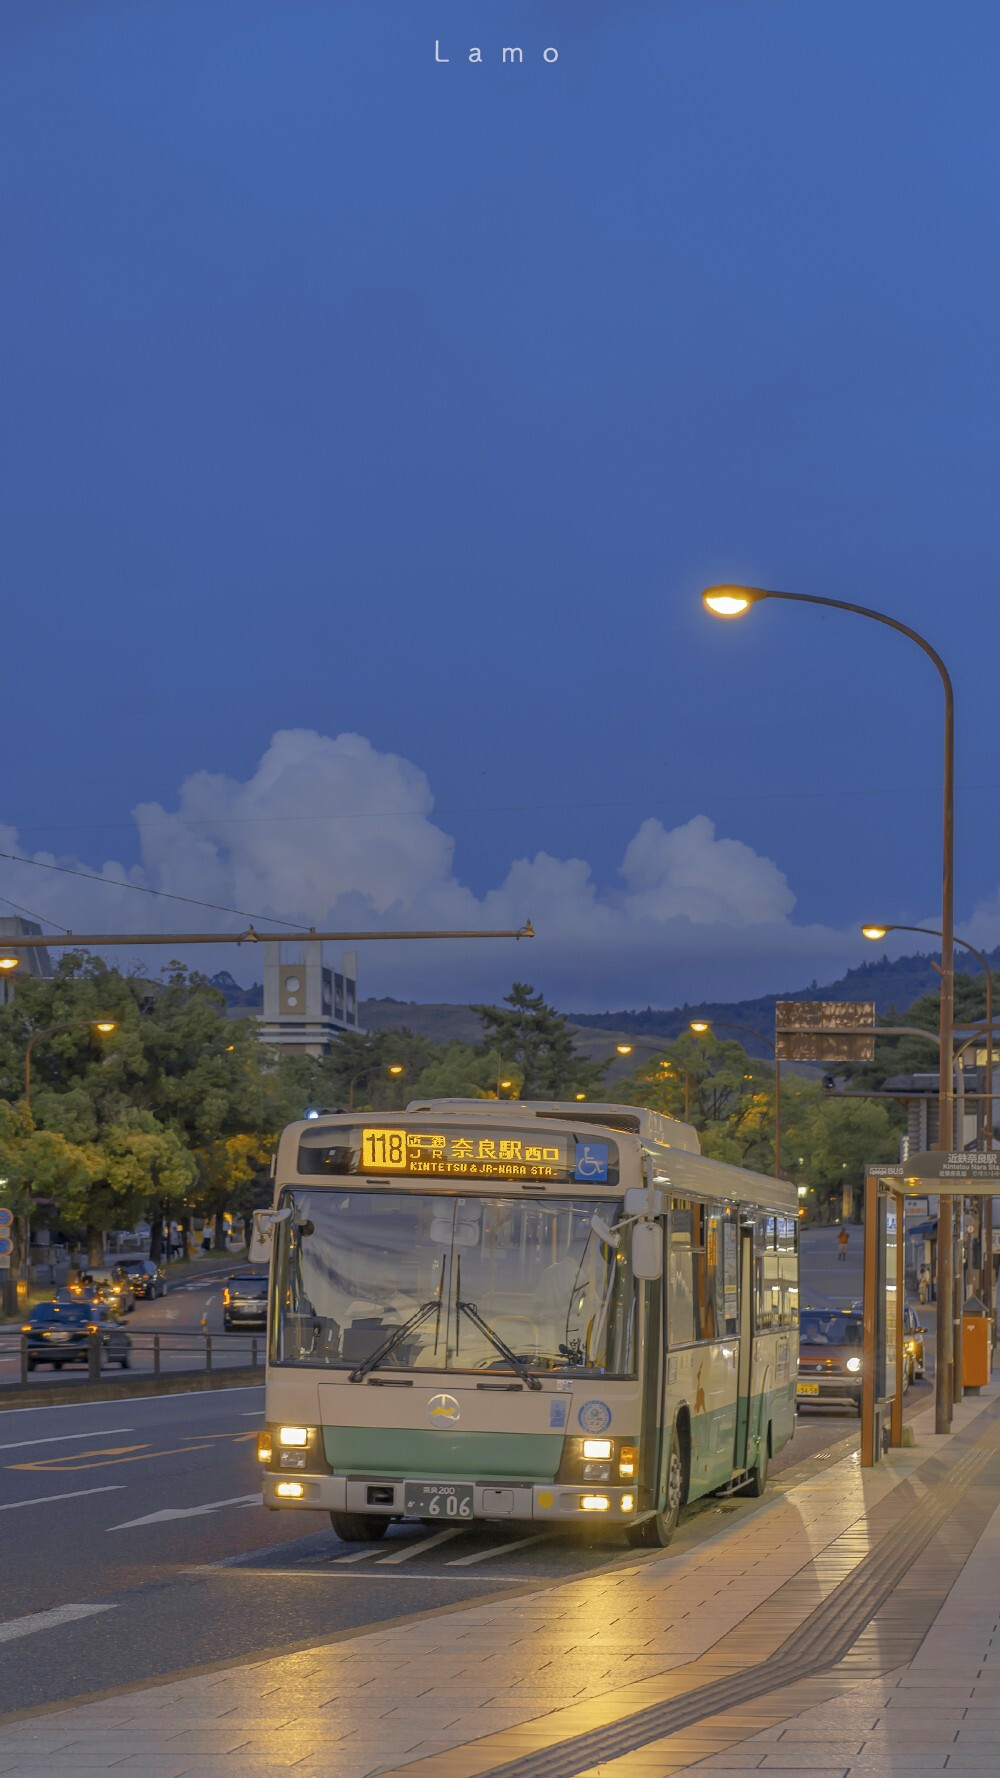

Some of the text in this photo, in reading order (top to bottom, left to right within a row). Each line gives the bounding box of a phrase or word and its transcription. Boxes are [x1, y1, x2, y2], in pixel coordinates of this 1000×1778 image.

[366, 1134, 402, 1163] 118
[947, 1153, 997, 1164] 近鉄奈良駅
[410, 1162, 467, 1172] KINTETSU
[531, 1167, 558, 1176] STA.
[888, 1167, 904, 1175] BUS
